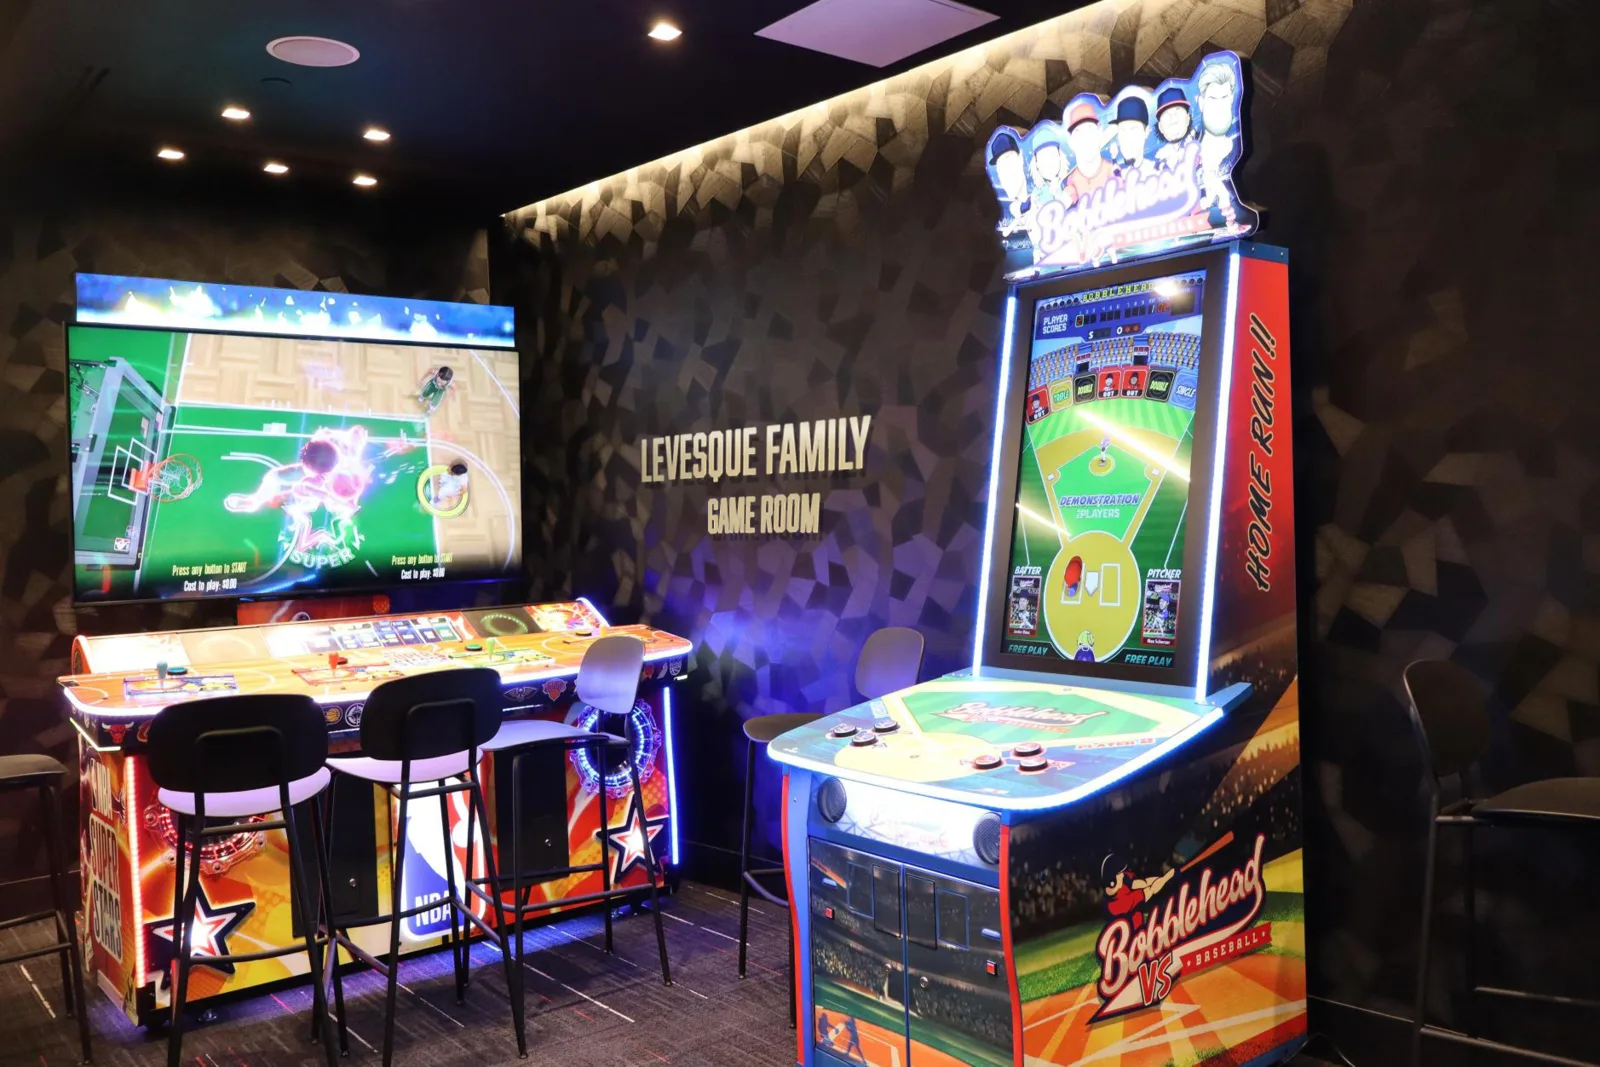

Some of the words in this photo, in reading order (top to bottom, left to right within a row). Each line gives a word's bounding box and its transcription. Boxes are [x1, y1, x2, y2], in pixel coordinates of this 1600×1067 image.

[1043, 314, 1068, 325] PLAYER
[1042, 323, 1067, 334] SCORES
[1077, 383, 1094, 396] DOUBLE
[1149, 380, 1169, 392] DOUBLE
[1177, 385, 1197, 398] SINGLE
[1102, 390, 1115, 398] OUT
[1126, 389, 1139, 397] OUT
[1033, 409, 1046, 420] OUT
[641, 427, 757, 483] LEVESQUE
[766, 414, 872, 475] FAMILY
[1059, 493, 1141, 506] DEMONSTRATION
[707, 496, 756, 535] GAME
[760, 492, 821, 534] ROOM
[1246, 452, 1272, 592] HOME
[289, 546, 356, 570] SUPER
[392, 554, 406, 566] Press
[407, 556, 417, 567] any
[418, 553, 434, 565] button
[172, 565, 190, 577] Press
[191, 566, 203, 577] any
[204, 563, 223, 575] button
[223, 563, 230, 574] to
[231, 561, 248, 573] START
[401, 569, 412, 580] Cost
[412, 569, 419, 579] to
[1014, 566, 1042, 575] BATTER
[1147, 568, 1181, 578] PITCHER
[184, 580, 197, 592] Cost
[198, 580, 205, 591] to
[206, 579, 221, 592] play:
[1008, 644, 1028, 654] FREE
[1028, 645, 1049, 655] PLAY
[1124, 654, 1148, 665] FREE
[1148, 656, 1173, 667] PLAY
[90, 815, 120, 896] SUPER
[415, 889, 452, 928] NBA
[93, 881, 122, 963] STARS
[1098, 834, 1265, 997] Bobblehead
[1195, 934, 1259, 967] BASEBALL
[1137, 951, 1173, 1006] VS
